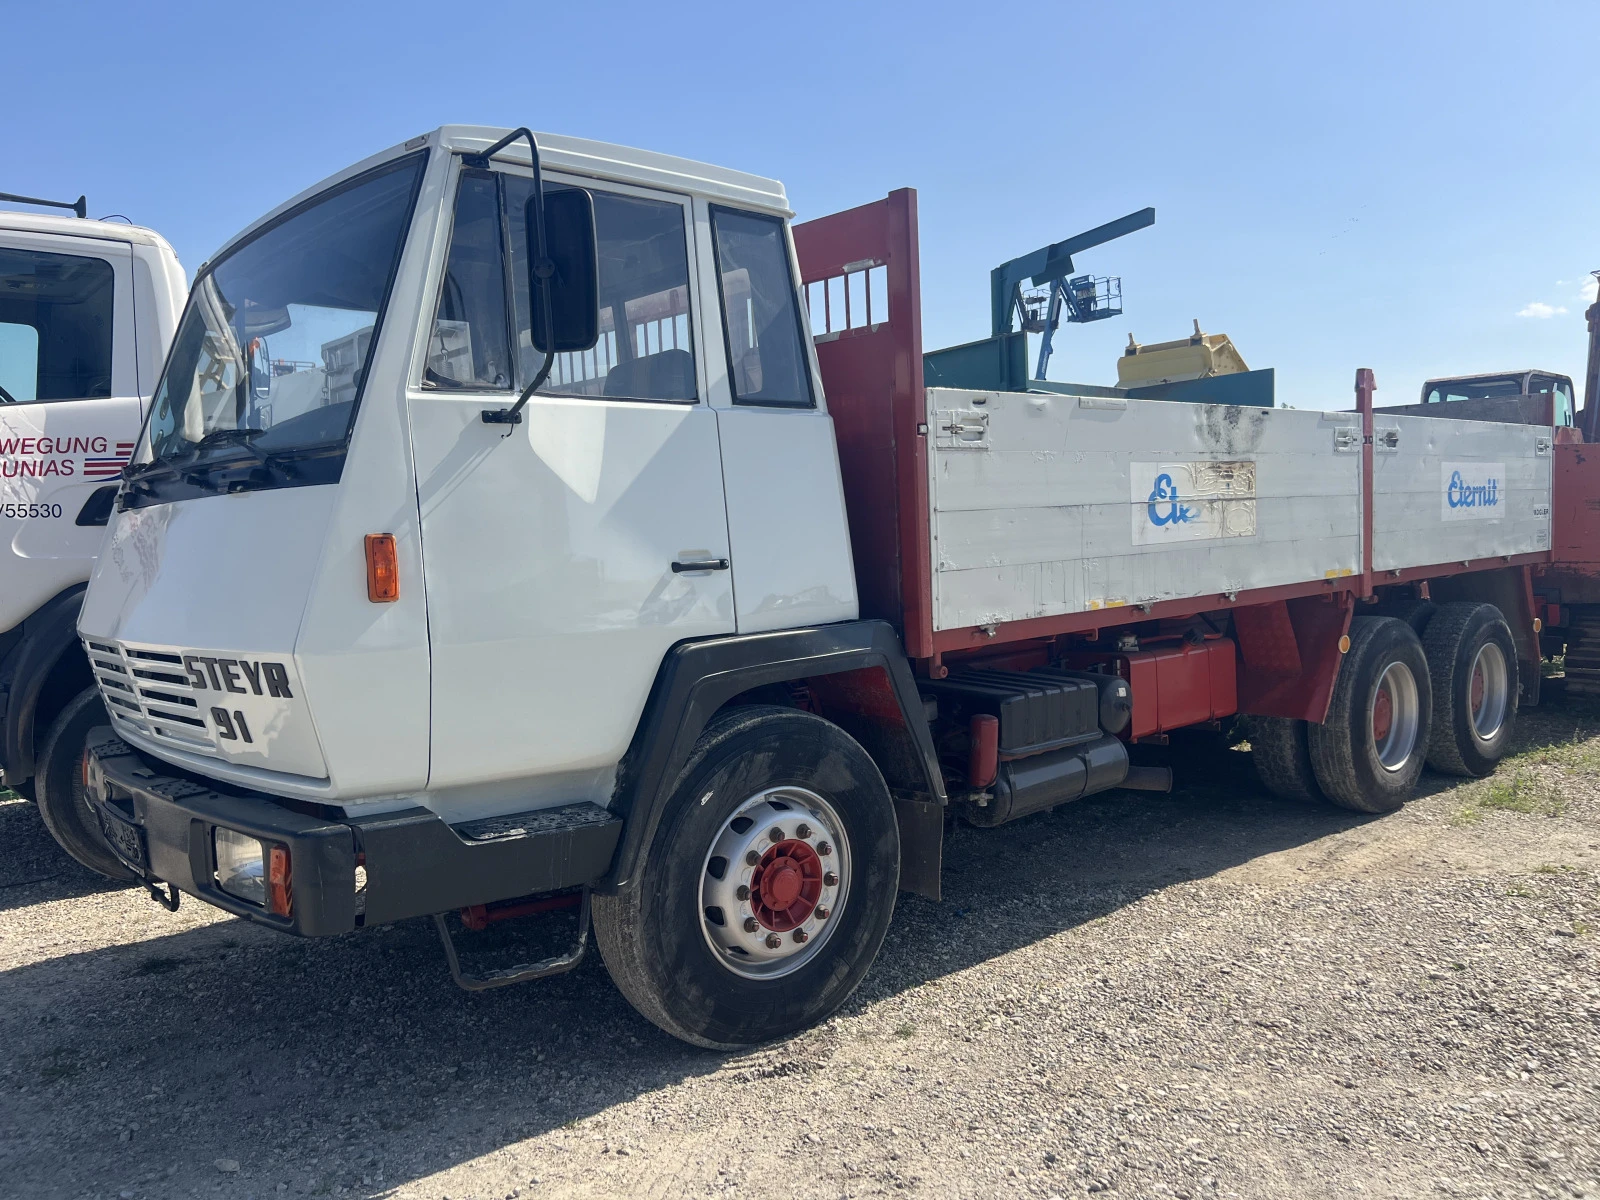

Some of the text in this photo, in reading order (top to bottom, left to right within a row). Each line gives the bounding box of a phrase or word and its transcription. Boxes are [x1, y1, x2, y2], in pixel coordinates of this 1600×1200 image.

[0, 437, 107, 455] WEGUNG
[0, 459, 75, 478] UNIAS
[1447, 470, 1498, 508] Eternit
[183, 655, 293, 698] STEYR
[210, 706, 253, 743] 91
